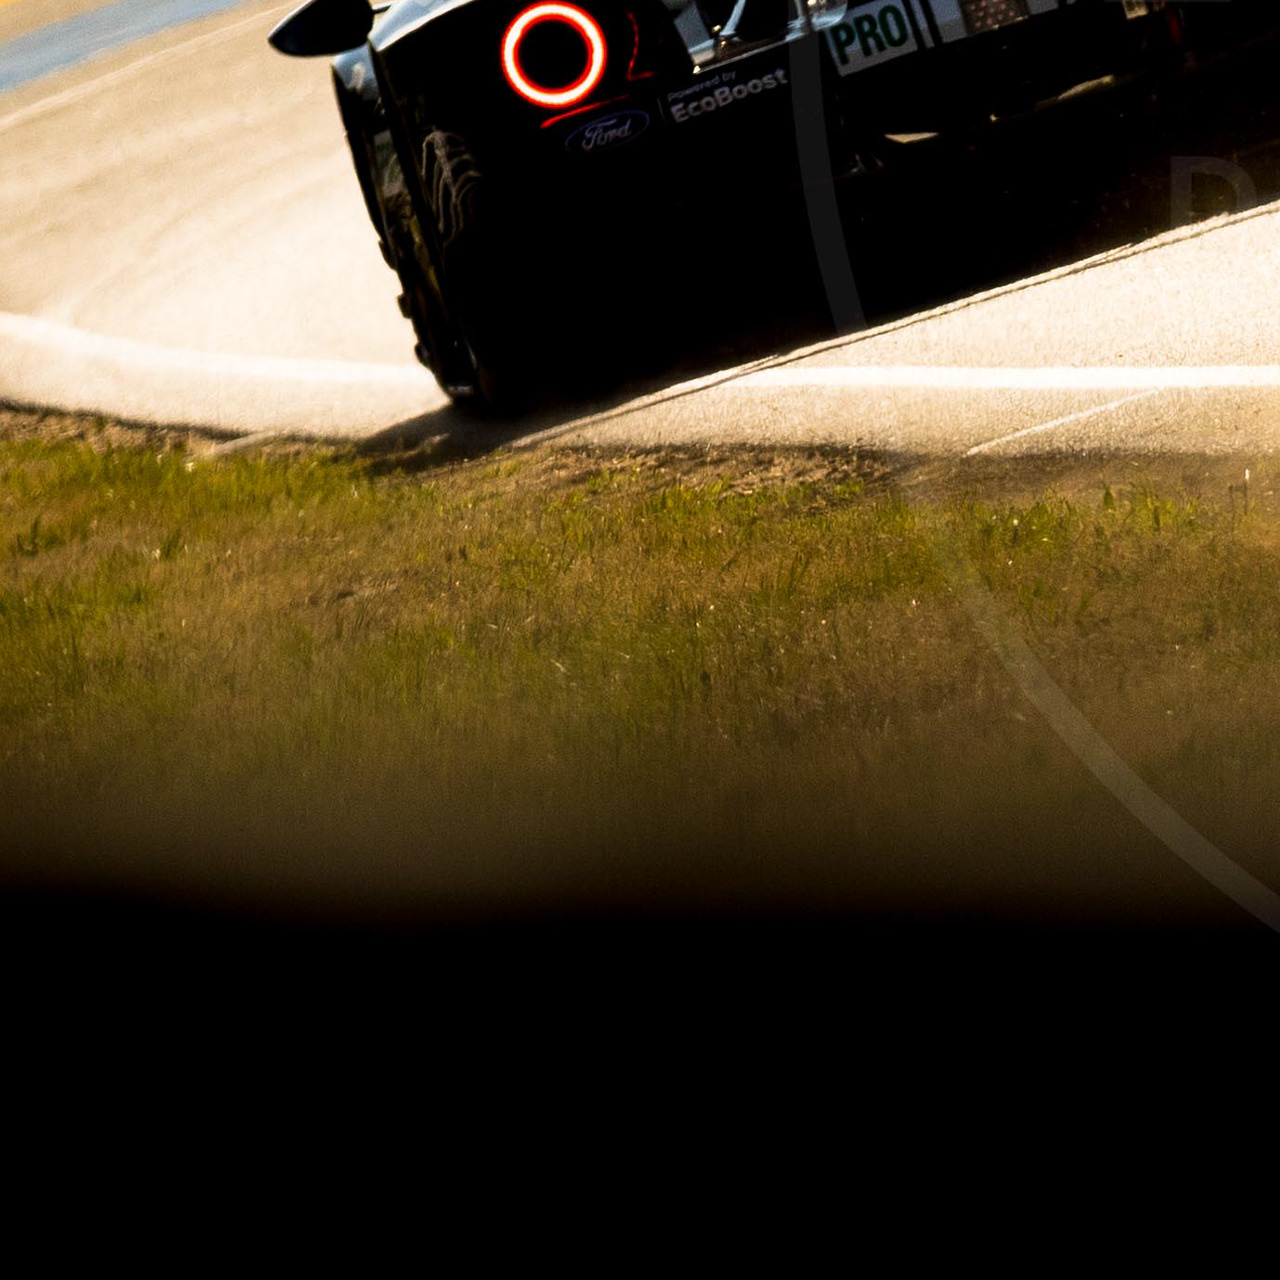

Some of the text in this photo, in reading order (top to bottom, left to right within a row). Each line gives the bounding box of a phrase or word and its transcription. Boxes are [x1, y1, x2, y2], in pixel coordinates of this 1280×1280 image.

[830, 4, 908, 66] PRO
[667, 77, 721, 102] Powered
[670, 67, 789, 124] EcoBoost
[581, 118, 631, 151] Ford
